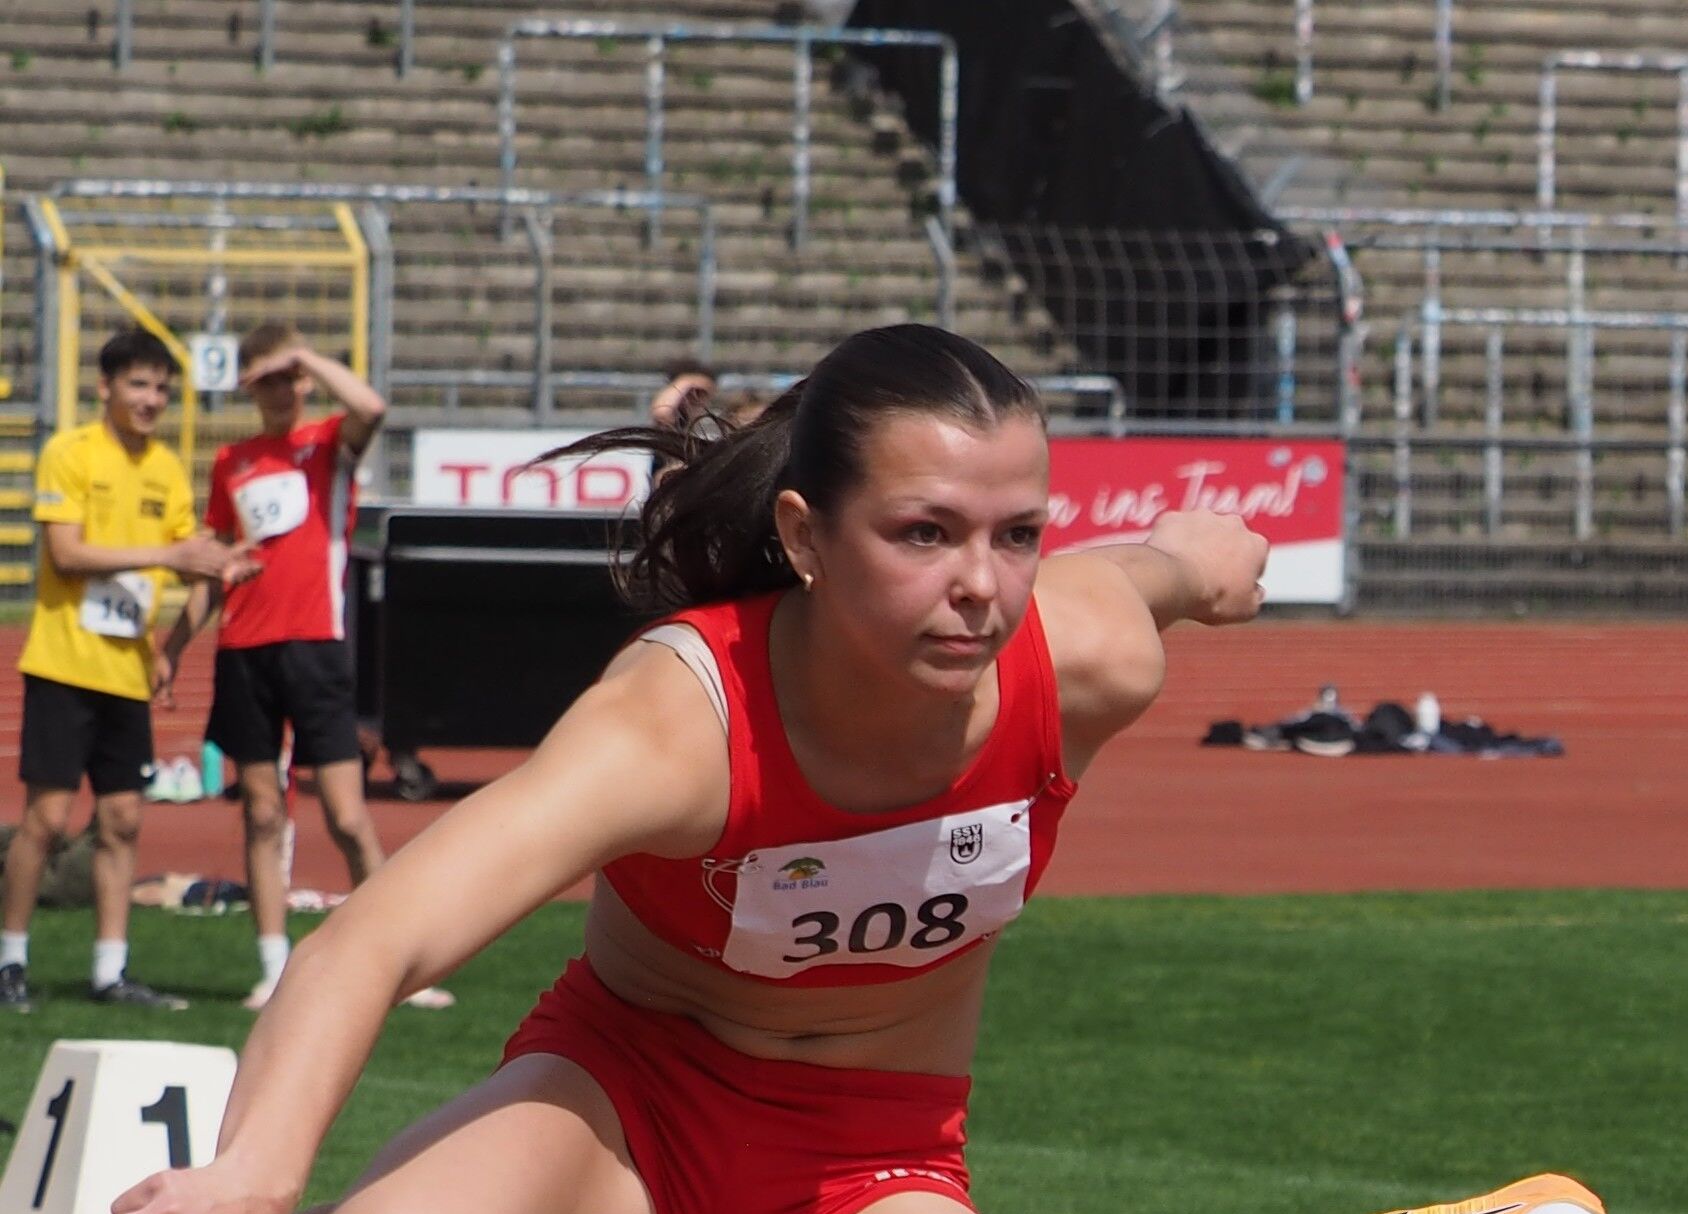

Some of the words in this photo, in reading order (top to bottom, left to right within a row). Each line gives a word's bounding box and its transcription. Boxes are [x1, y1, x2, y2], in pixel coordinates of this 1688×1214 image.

[203, 346, 226, 384] 9
[953, 825, 981, 839] SSV
[773, 880, 797, 891] Bad
[783, 893, 969, 963] 308
[34, 1079, 74, 1208] 1
[141, 1086, 192, 1168] 1
